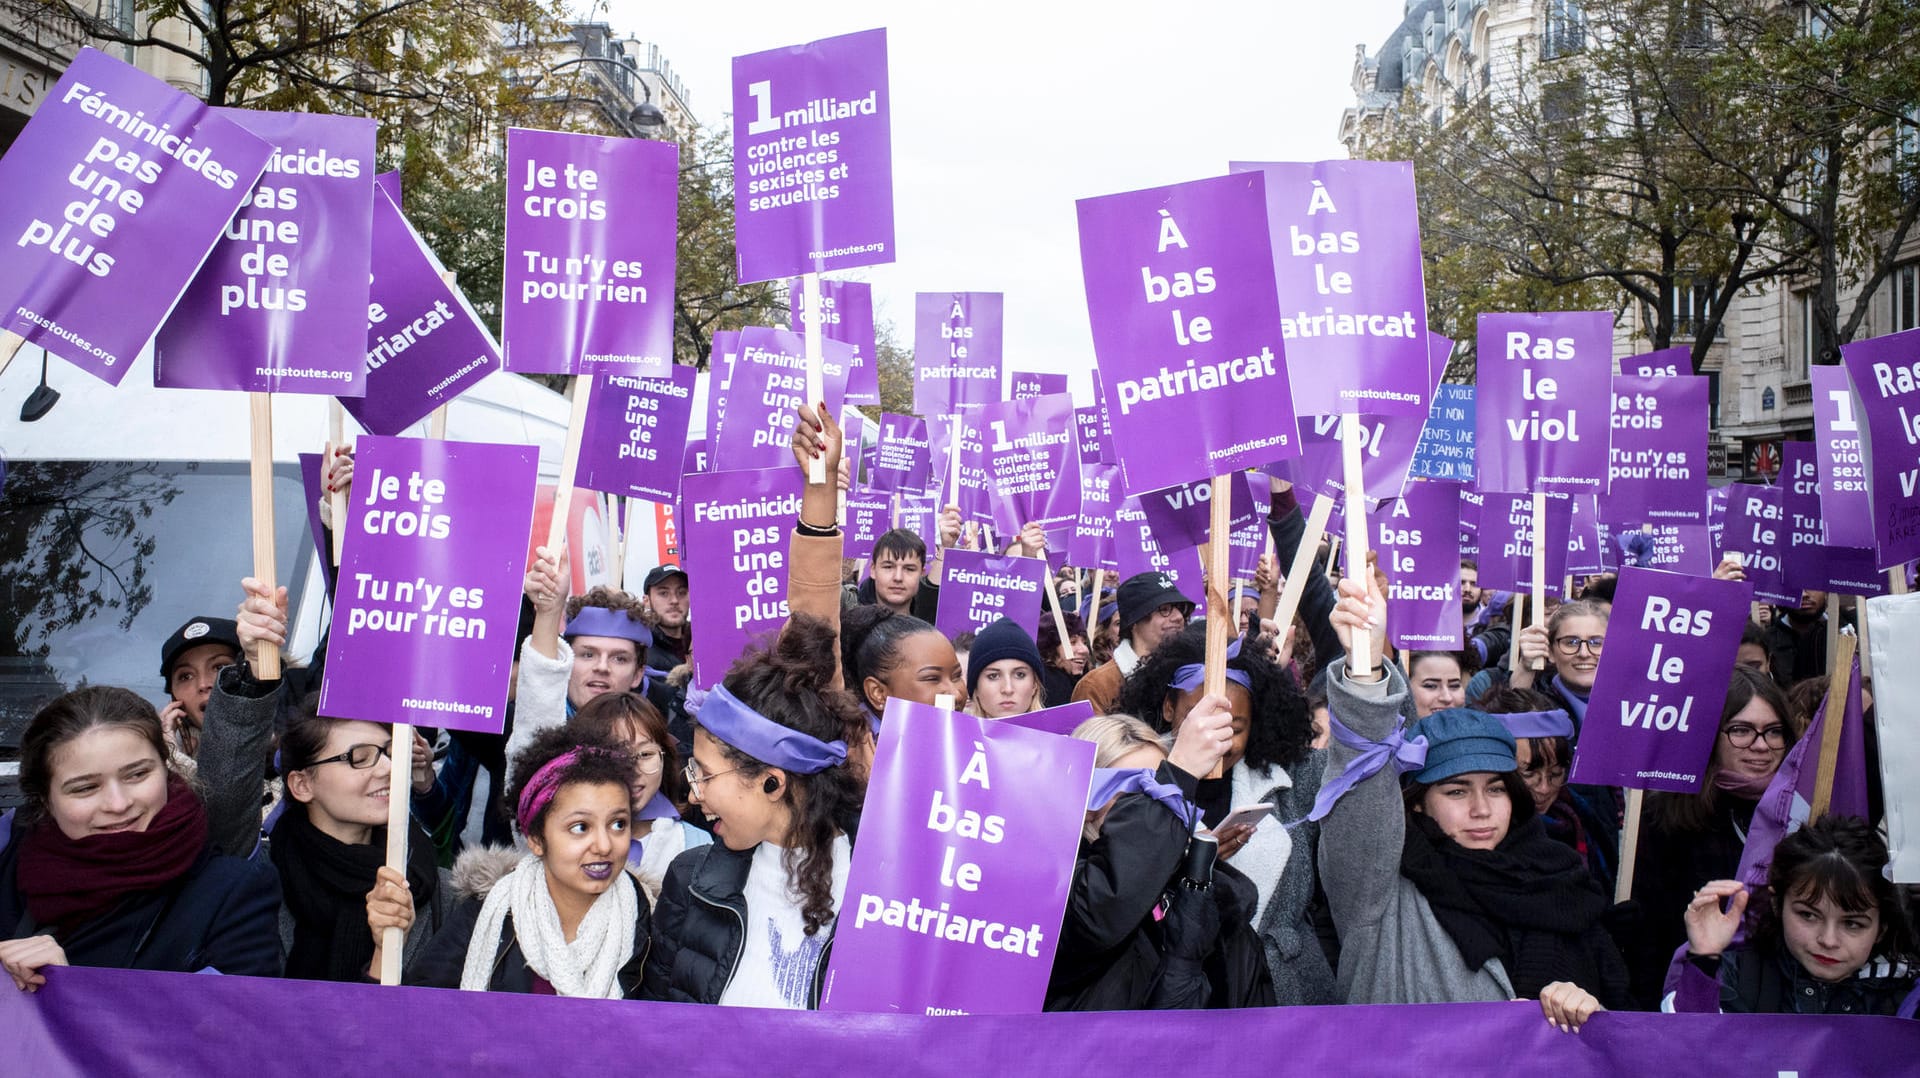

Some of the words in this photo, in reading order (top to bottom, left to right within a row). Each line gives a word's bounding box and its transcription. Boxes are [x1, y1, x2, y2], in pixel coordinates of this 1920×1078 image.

[748, 79, 781, 136] 1
[784, 90, 877, 128] milliard
[62, 82, 239, 190] Féminicides
[747, 133, 807, 159] contre
[811, 129, 840, 148] les
[84, 136, 163, 184] pas
[748, 149, 838, 177] violences
[523, 159, 557, 191] Je
[564, 163, 599, 190] te
[748, 167, 825, 195] sexistes
[829, 162, 848, 180] et
[68, 163, 144, 214] une
[748, 184, 840, 212] sexuelles
[1306, 180, 1337, 216] À
[64, 198, 116, 238] de
[524, 192, 607, 221] crois
[225, 218, 299, 244] une
[1157, 208, 1189, 253] À
[1289, 225, 1360, 256] bas
[17, 218, 116, 278] plus
[808, 242, 885, 260] noustoutes.org
[240, 244, 289, 277] de
[523, 250, 558, 273] Tu
[612, 260, 643, 279] es
[1141, 266, 1217, 304] bas
[1315, 263, 1353, 295] le
[221, 277, 307, 316] plus
[522, 279, 590, 304] pour
[595, 279, 648, 304] rien
[950, 300, 964, 319] À
[941, 322, 973, 338] bas
[1172, 309, 1213, 346] le
[1281, 306, 1416, 339] atriarcat
[16, 306, 117, 366] noustoutes.org
[365, 299, 456, 375] triarcat
[1506, 331, 1576, 361] Ras
[584, 353, 662, 366] noustoutes.org
[950, 342, 968, 358] le
[255, 366, 353, 382] noustoutes.org
[426, 353, 489, 398] noustoutes.org
[766, 372, 806, 391] pas
[920, 363, 997, 381] patriarcat
[1116, 346, 1276, 416] patriarcat
[1016, 381, 1027, 392] Je
[1029, 381, 1041, 391] te
[1340, 388, 1421, 405] noustoutes.org
[1522, 368, 1558, 401] le
[627, 394, 659, 411] pas
[762, 391, 803, 411] une
[1635, 393, 1657, 411] te
[1829, 390, 1858, 431] 1
[625, 409, 658, 428] une
[767, 408, 794, 429] de
[1506, 409, 1580, 442] viol
[1611, 411, 1663, 430] crois
[629, 425, 651, 443] de
[883, 424, 897, 443] 1
[896, 436, 929, 448] milliard
[961, 424, 977, 438] Je
[990, 420, 1013, 452] 1
[1013, 428, 1070, 449] milliard
[1084, 427, 1097, 438] le
[618, 440, 657, 461] plus
[992, 453, 1031, 466] contre
[1032, 450, 1050, 462] les
[1209, 434, 1288, 460] noustoutes.org
[1610, 448, 1632, 463] Tu
[1666, 452, 1687, 465] es
[994, 461, 1049, 476] violences
[995, 472, 1043, 487] sexistes
[1044, 470, 1056, 480] et
[1435, 461, 1454, 477] SON
[1538, 475, 1600, 486] noustoutes.org
[1609, 466, 1652, 481] pour
[1655, 464, 1690, 480] rien
[1793, 459, 1815, 479] Je
[365, 468, 400, 505] Je
[408, 471, 446, 504] te
[629, 484, 673, 499] noustoutes.org
[997, 481, 1051, 497] sexuelles
[1095, 477, 1109, 489] te
[1165, 480, 1212, 511] vio
[1511, 499, 1534, 513] pa
[694, 493, 803, 523] Féminicide
[1648, 510, 1700, 519] noustoutes.org
[363, 505, 451, 540] crois
[1076, 526, 1105, 537] pour
[1379, 522, 1422, 546] bas
[1661, 525, 1679, 535] les
[1752, 522, 1776, 545] le
[1792, 514, 1815, 530] Tu
[733, 526, 780, 552] pas
[1503, 541, 1534, 558] plu
[1568, 535, 1585, 551] ol
[1672, 545, 1685, 554] et
[1791, 532, 1824, 547] pou
[733, 550, 783, 573] une
[1150, 551, 1170, 567] de
[1393, 550, 1415, 573] le
[355, 573, 389, 602] Tu
[449, 586, 484, 610] es
[746, 571, 779, 597] de
[948, 568, 1038, 593] Féminicides
[1388, 580, 1453, 601] riarcat
[1828, 578, 1882, 591] noustoutes.org
[971, 591, 1005, 607] pas
[347, 607, 418, 636] pour
[423, 608, 486, 640] rien
[735, 596, 791, 629] plus
[1640, 595, 1713, 637] Ras
[1400, 633, 1455, 644] noustoutes.org
[1646, 643, 1685, 684] le
[402, 696, 493, 719] noustoutes.org
[1620, 694, 1694, 732] viol
[958, 740, 991, 790] À
[1636, 769, 1697, 783] noustoutes.org
[927, 790, 1006, 844] bas
[939, 846, 982, 892] le
[854, 892, 1044, 958] patriarcat
